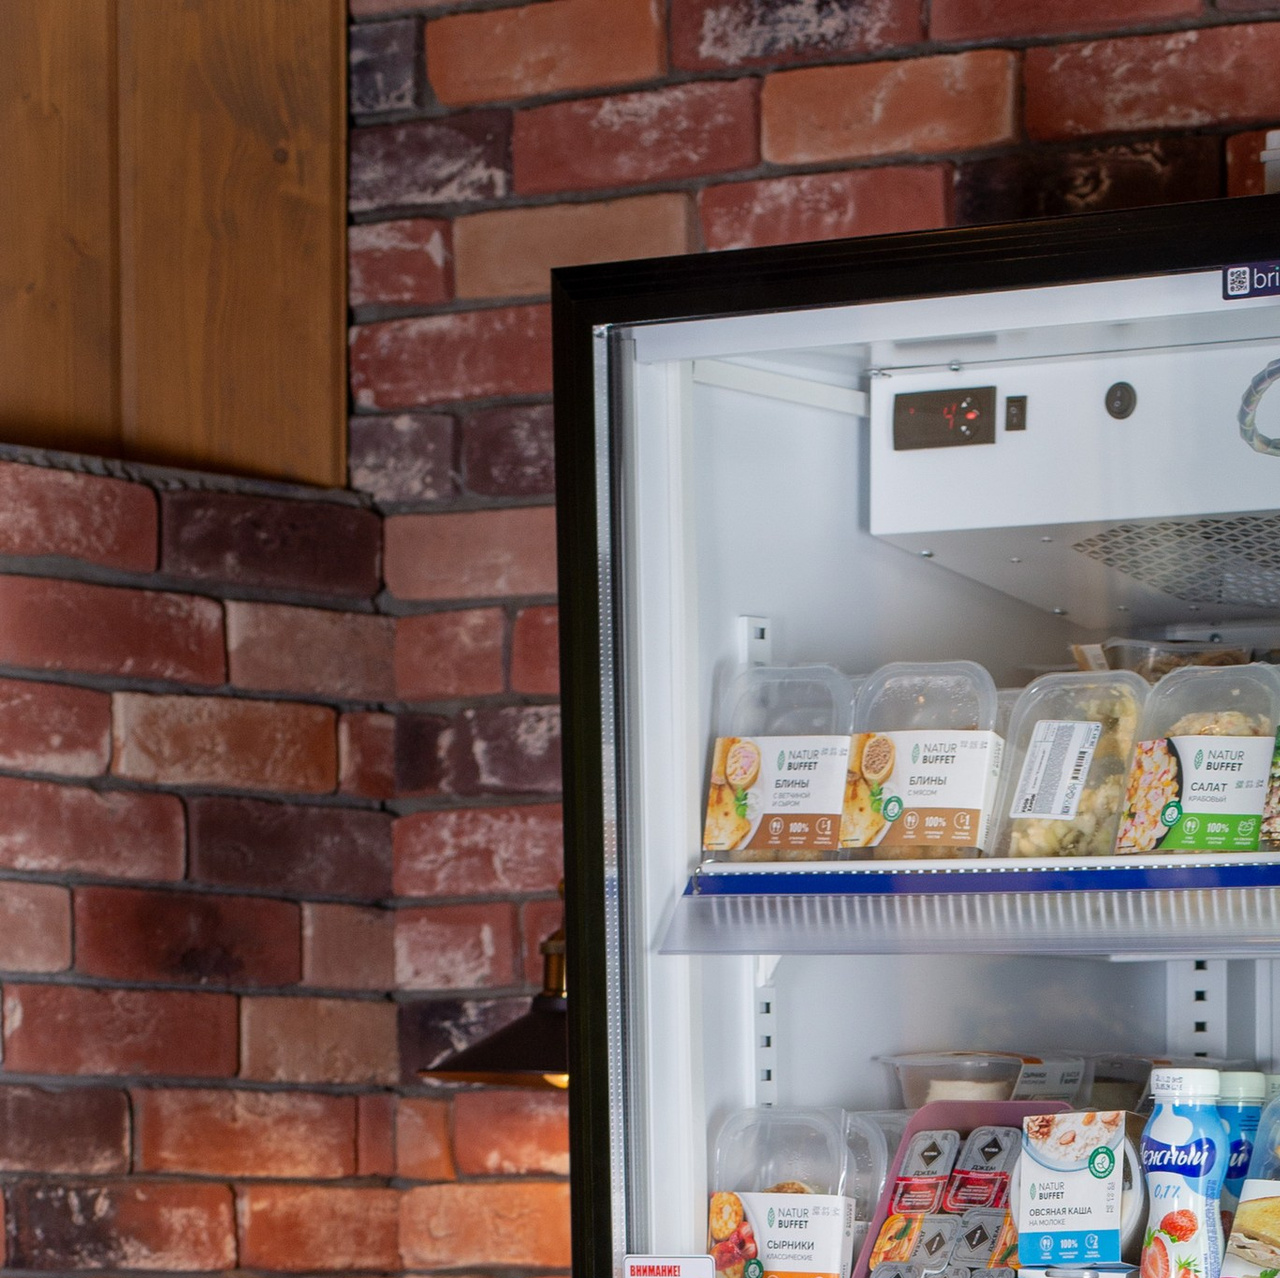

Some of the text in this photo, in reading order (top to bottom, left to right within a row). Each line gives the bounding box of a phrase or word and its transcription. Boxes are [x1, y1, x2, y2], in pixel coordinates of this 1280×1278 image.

[923, 743, 957, 753] NATUR
[788, 749, 819, 760] NATUR
[922, 755, 956, 764] BUFFET
[1207, 750, 1244, 761] NATUR
[787, 761, 818, 771] BUFFET
[1206, 762, 1243, 772] BUFFET
[775, 779, 809, 789] БЛИНЫ
[909, 776, 947, 786] БЛИНЫ
[1190, 782, 1228, 792] САЛАТ
[1188, 795, 1227, 803] КРАБОВЫЙ
[1038, 1182, 1065, 1191] NATUR
[1039, 1191, 1065, 1201] BUFFET
[778, 1207, 809, 1218] NATUR
[1029, 1206, 1092, 1217] ОВСЯНАЯ КАША
[778, 1219, 809, 1229] BUFFET
[1029, 1218, 1066, 1227] НА МОЛОКЕ
[766, 1240, 815, 1251] СЫРНИКИ
[629, 1265, 681, 1277] ВНИМАНИЕ!
